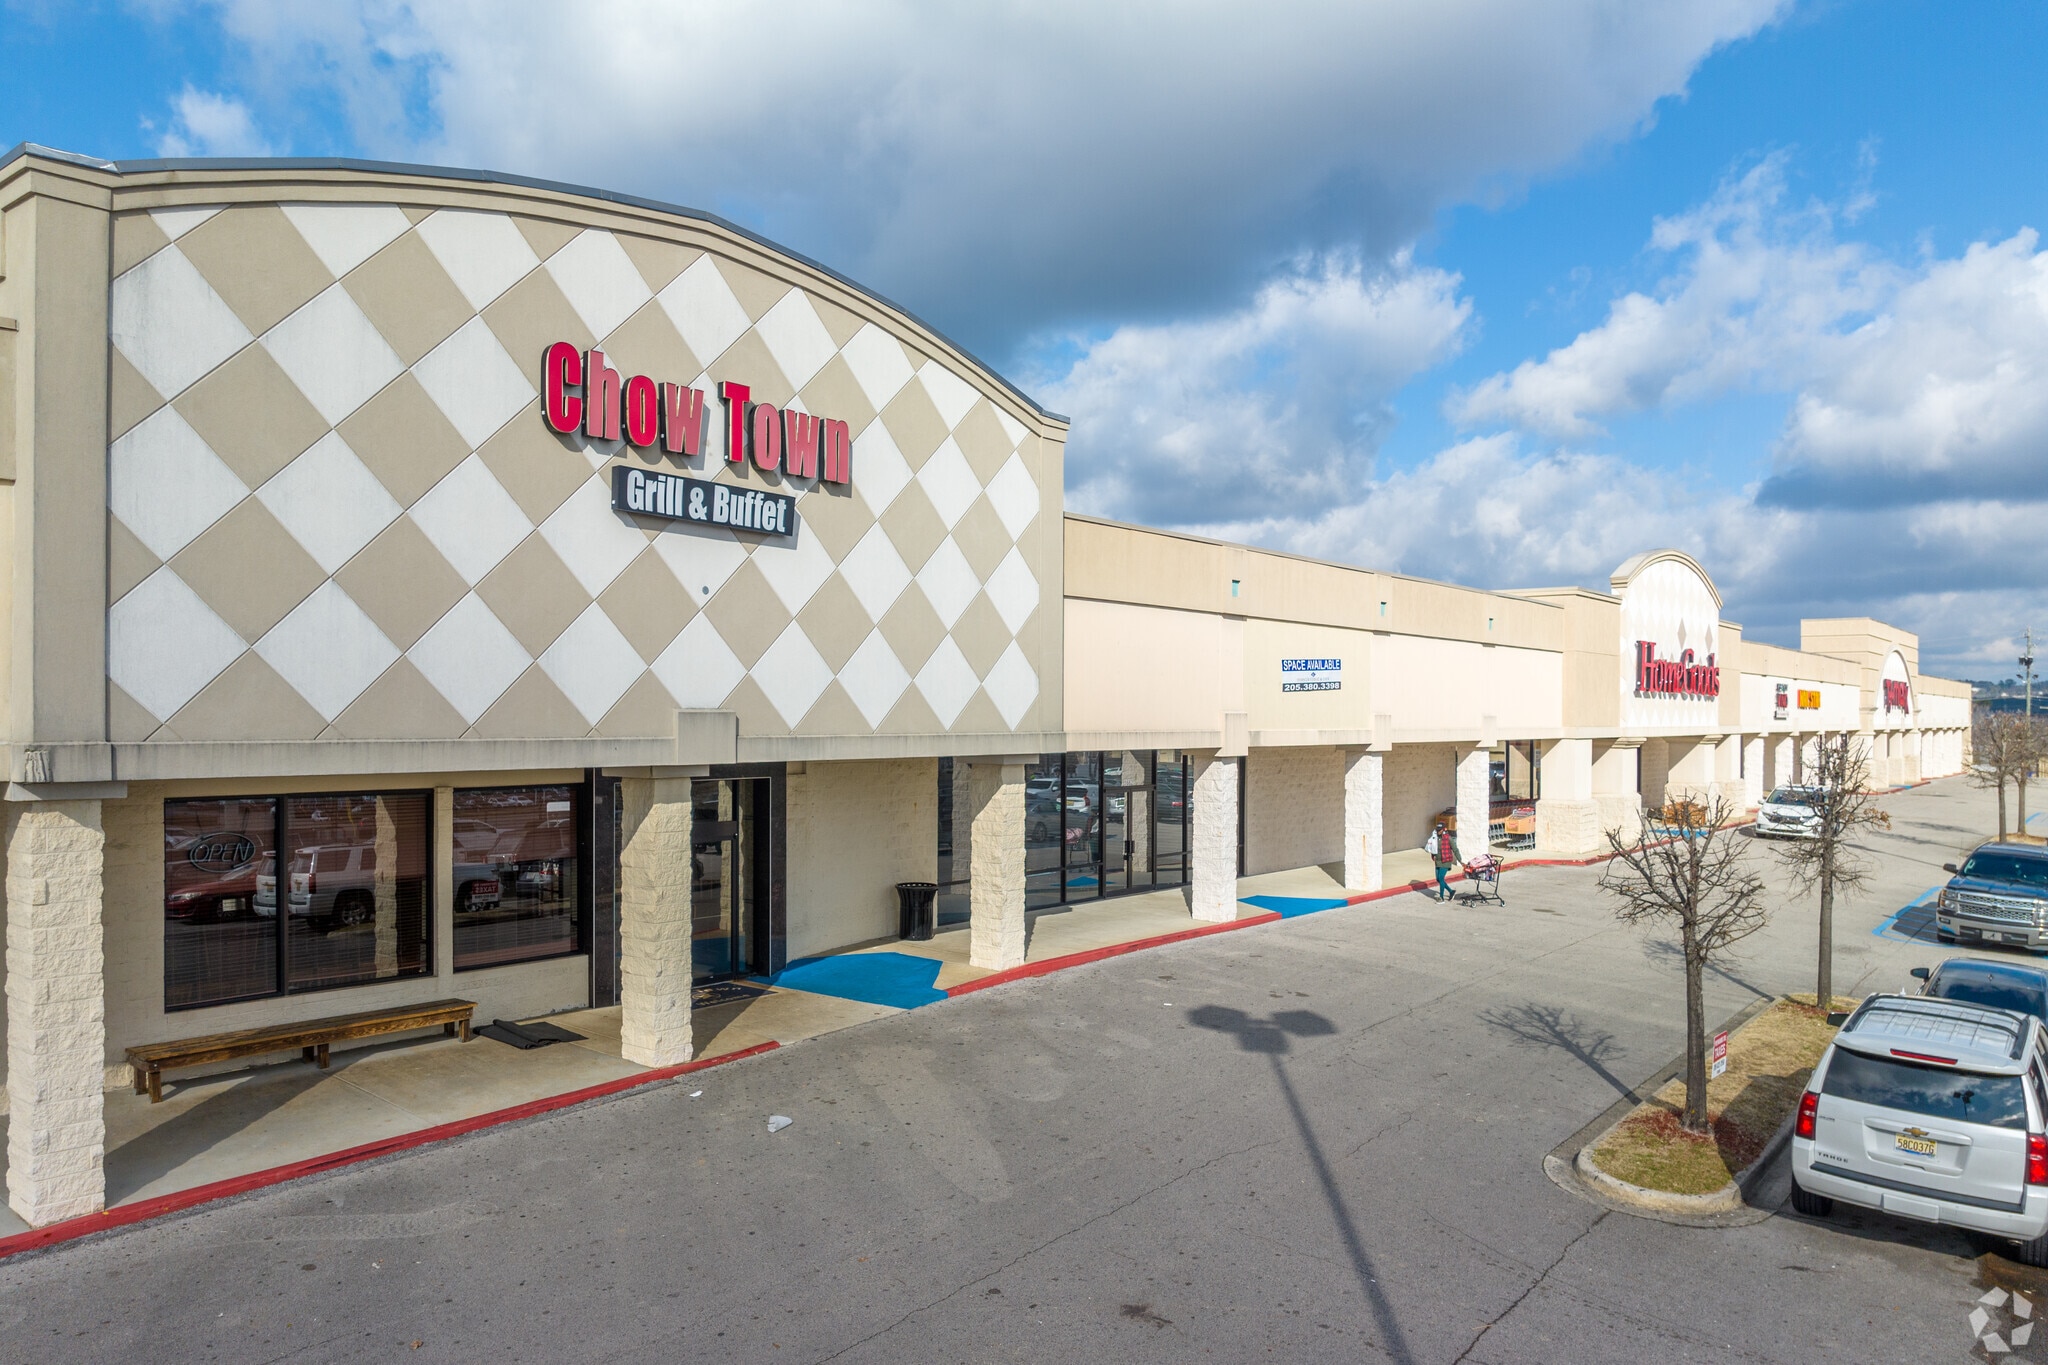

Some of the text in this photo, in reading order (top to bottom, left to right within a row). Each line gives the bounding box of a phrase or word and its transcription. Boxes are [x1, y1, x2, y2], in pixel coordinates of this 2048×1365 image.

[542, 341, 849, 485] Chow Town
[626, 470, 787, 533] Grill & Buffet
[1283, 659, 1340, 671] SPACE AVAILABLE
[1636, 640, 1720, 697] HomeGoods
[194, 842, 251, 862] OPEN
[1897, 1138, 1935, 1154] 58C037G
[1818, 1152, 1848, 1163] TAHOE
